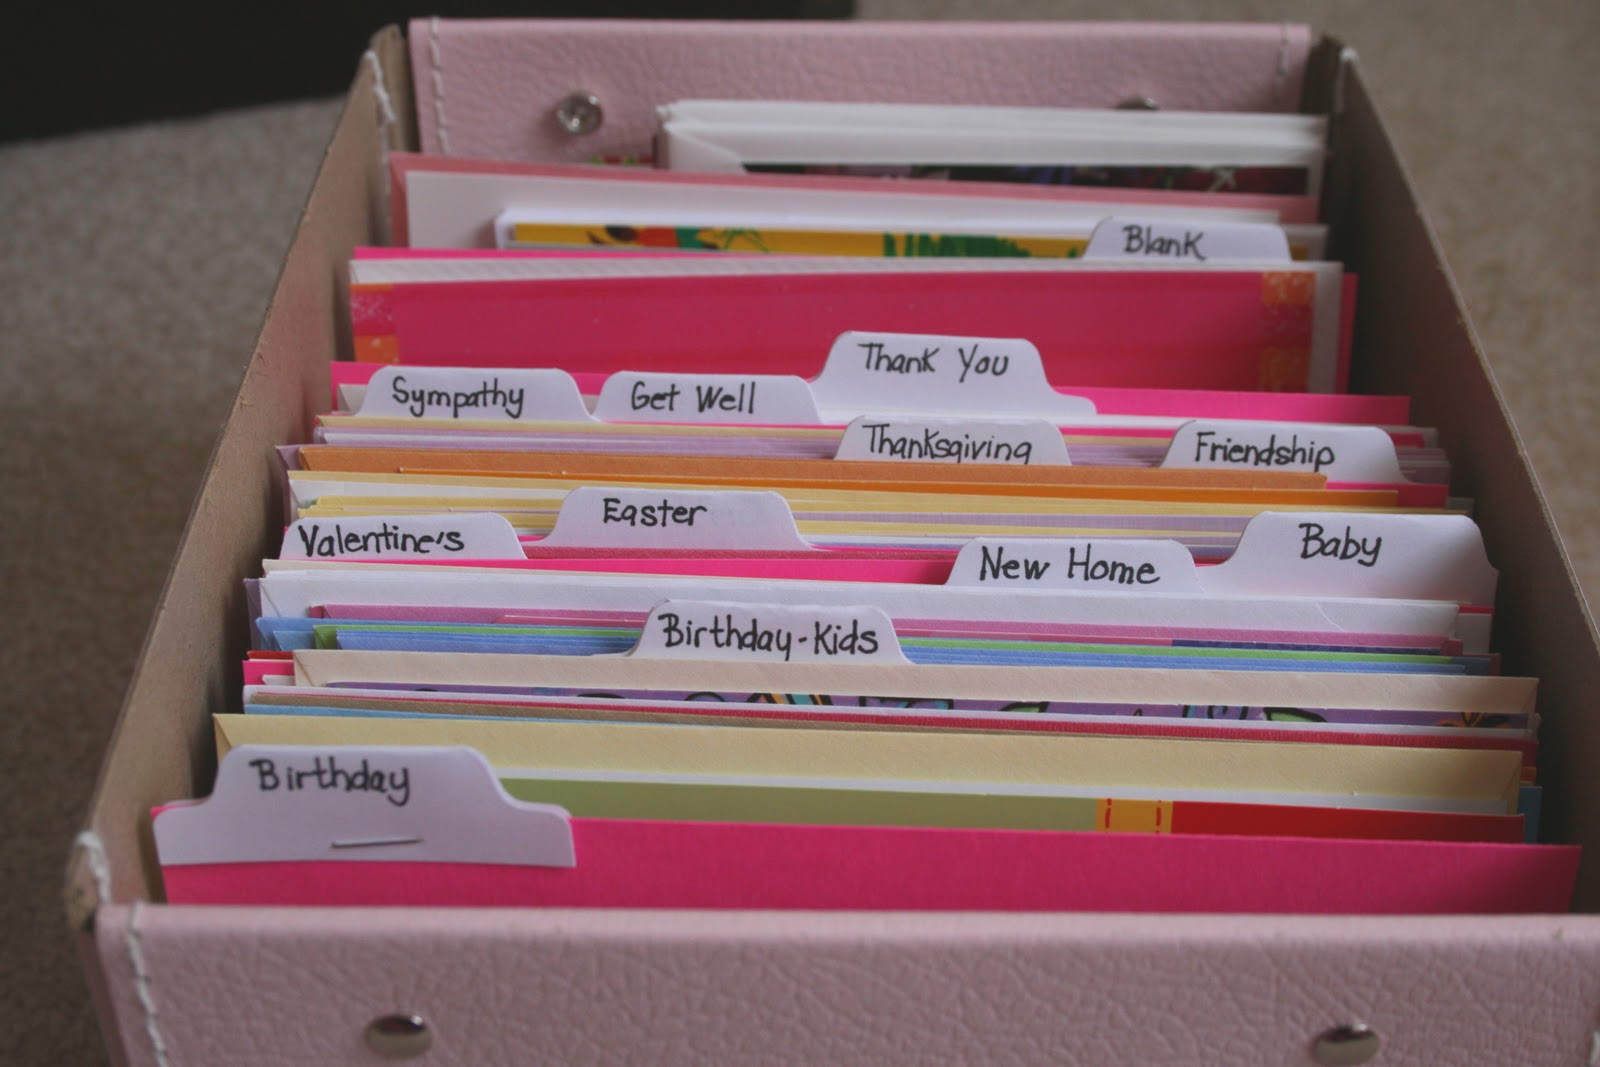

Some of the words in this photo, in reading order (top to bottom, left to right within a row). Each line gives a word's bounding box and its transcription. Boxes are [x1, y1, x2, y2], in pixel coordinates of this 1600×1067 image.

[957, 343, 1009, 383] You
[391, 376, 524, 420] Sympathy
[630, 380, 681, 412] Get
[696, 381, 757, 414] Well
[1194, 431, 1336, 472] Friendship
[602, 497, 708, 528] Easter
[297, 522, 465, 558] Valentine's
[1298, 522, 1383, 568] Baby
[979, 545, 1051, 582] New
[1067, 543, 1161, 585] Home
[248, 755, 411, 808] Birthday
